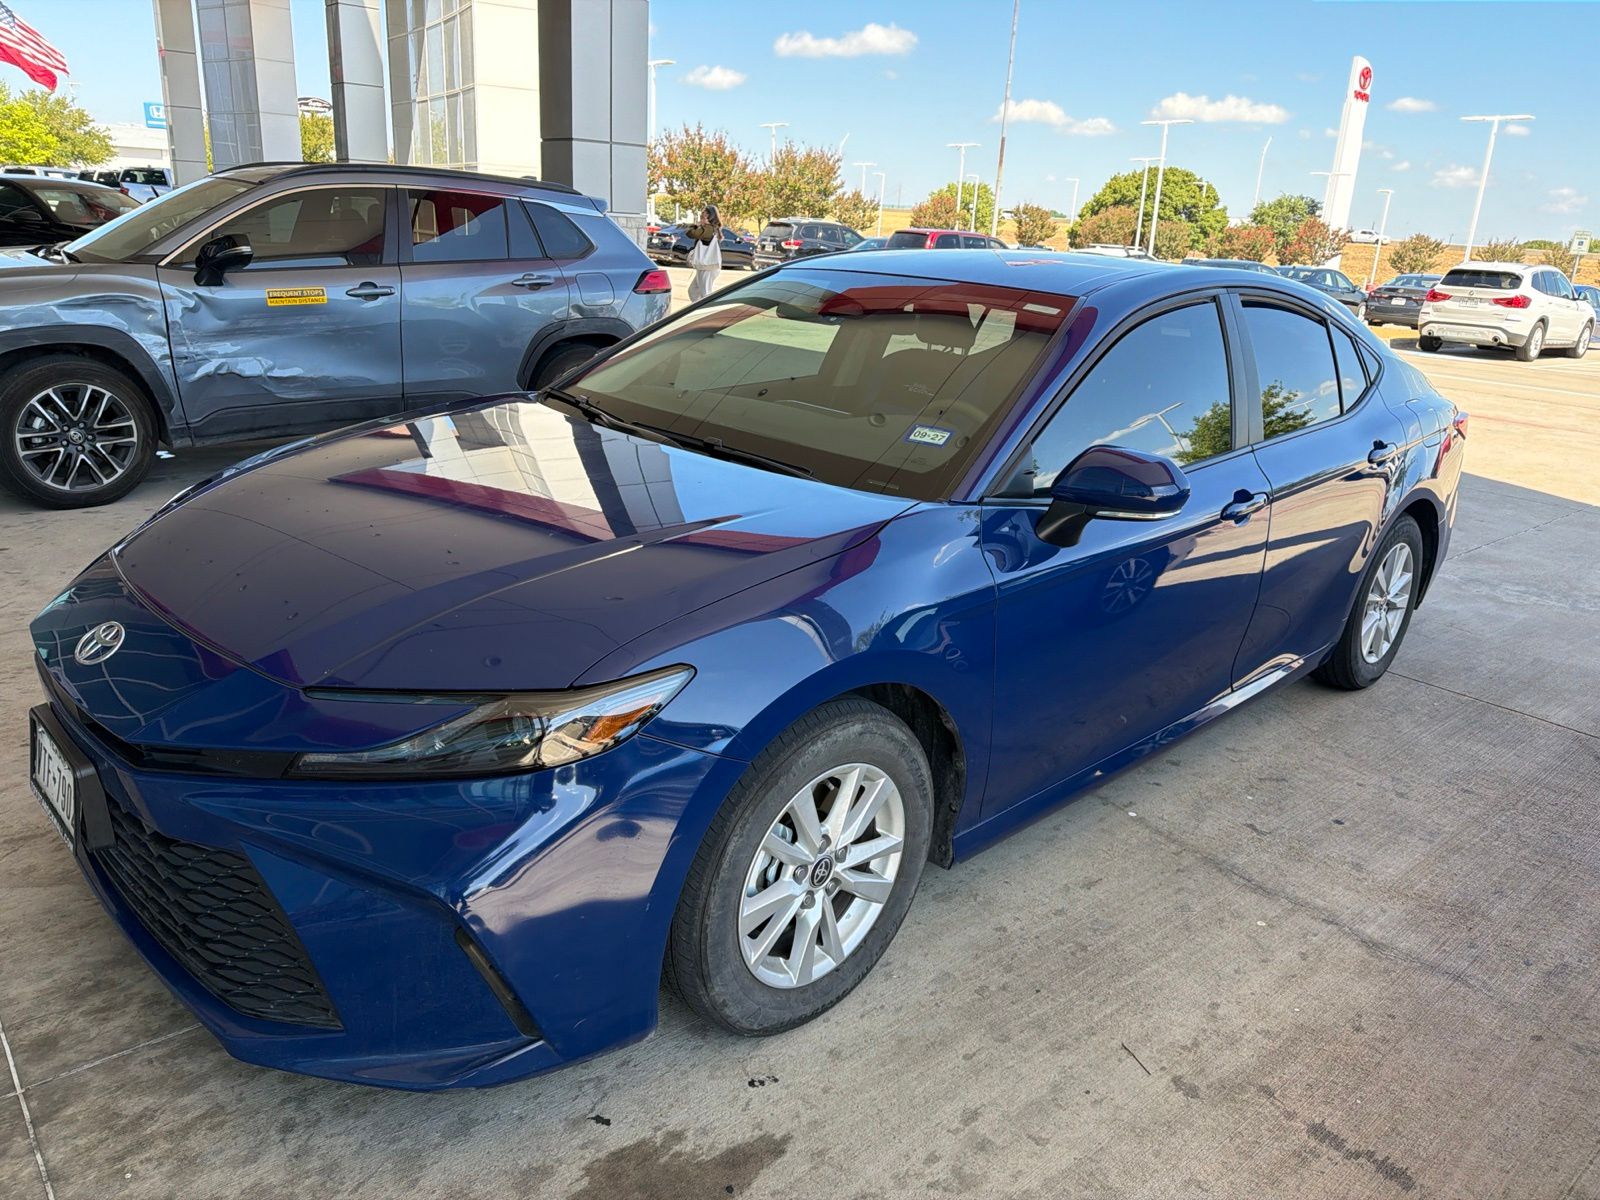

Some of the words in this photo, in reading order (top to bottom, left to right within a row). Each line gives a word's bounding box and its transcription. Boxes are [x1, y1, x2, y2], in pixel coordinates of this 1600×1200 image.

[270, 290, 302, 298] FREQUENT
[303, 289, 323, 297] STOPS
[930, 433, 946, 441] 27
